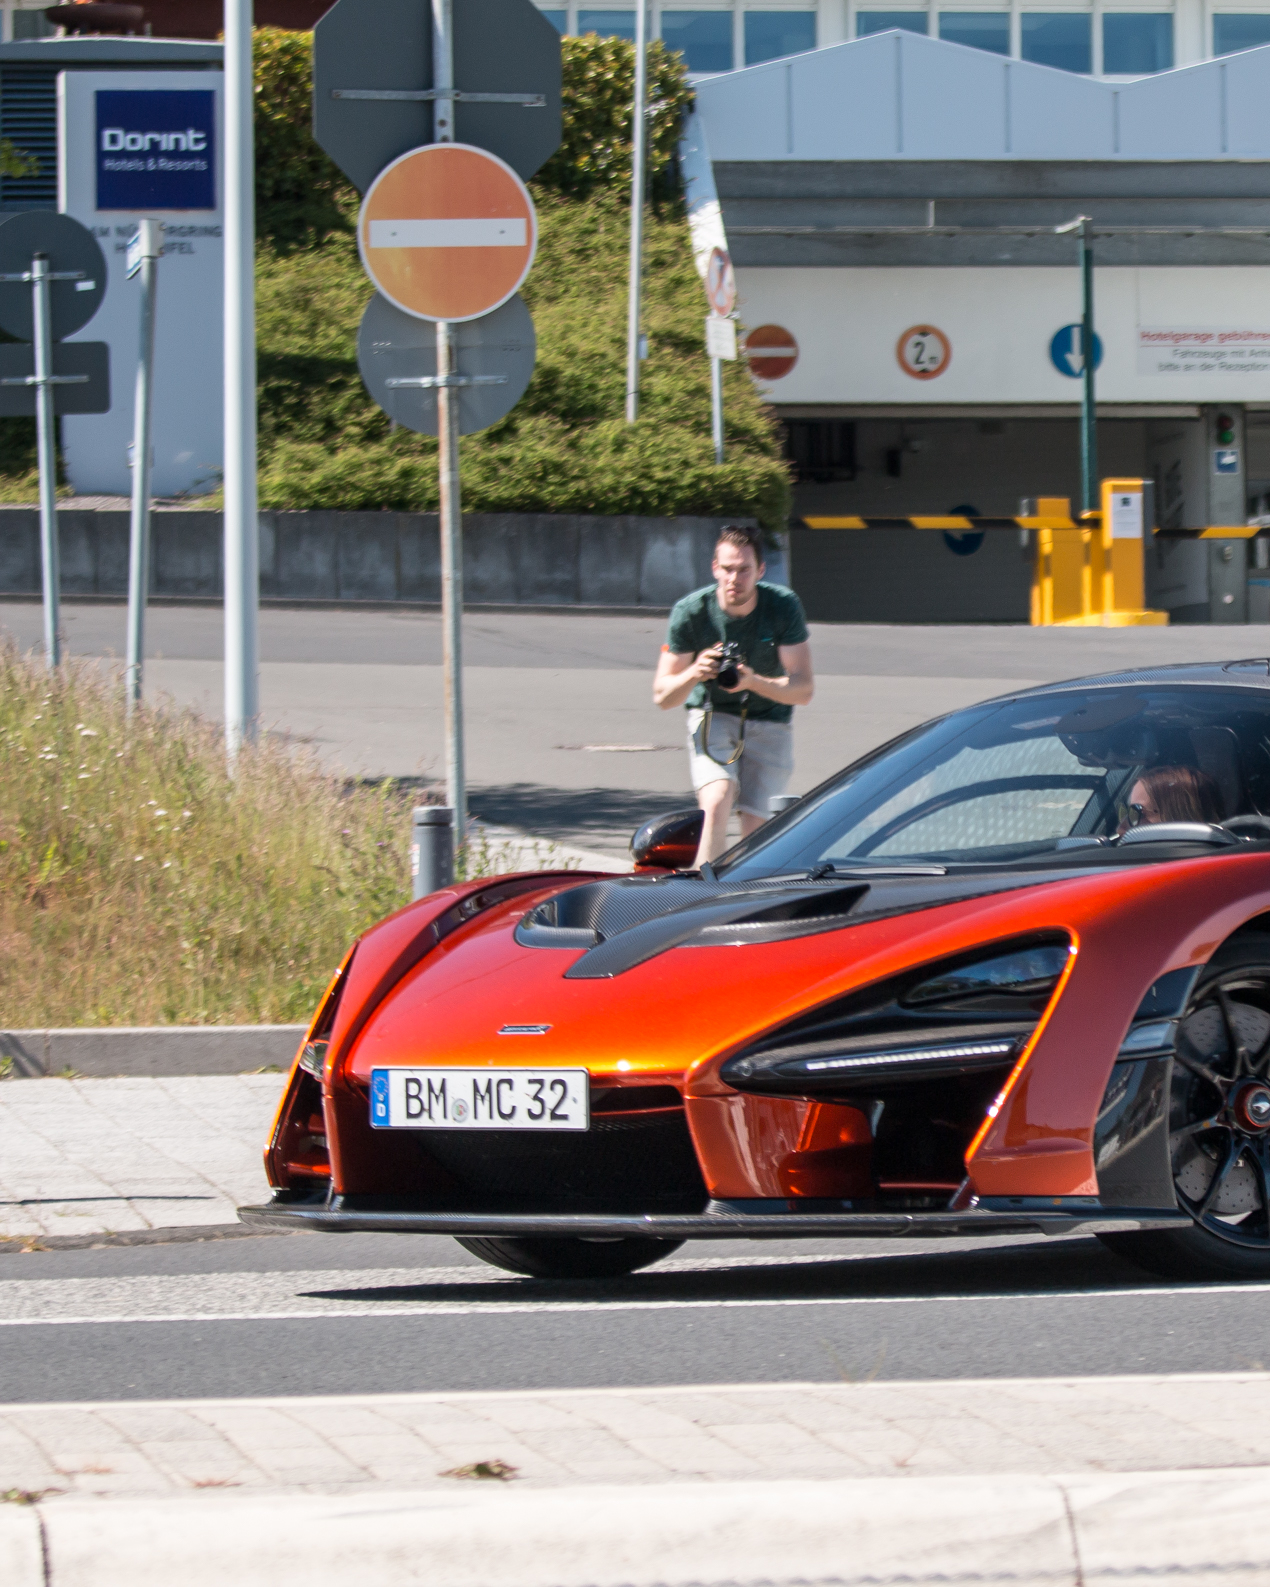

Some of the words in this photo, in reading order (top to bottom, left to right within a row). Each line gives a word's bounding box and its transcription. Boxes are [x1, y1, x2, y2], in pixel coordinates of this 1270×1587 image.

[102, 128, 207, 151] Dorint
[104, 158, 145, 171] Hotels
[147, 158, 157, 171] &
[158, 158, 208, 171] Resorts
[1140, 331, 1214, 344] Hotelgarage
[913, 340, 925, 365] 2
[1172, 348, 1227, 360] Fahrzeuge
[1229, 349, 1245, 359] mit
[1157, 362, 1180, 372] bitte
[1183, 364, 1195, 372] an
[1199, 362, 1216, 372] der
[1218, 362, 1270, 373] Rezeption
[405, 1077, 447, 1120] BM
